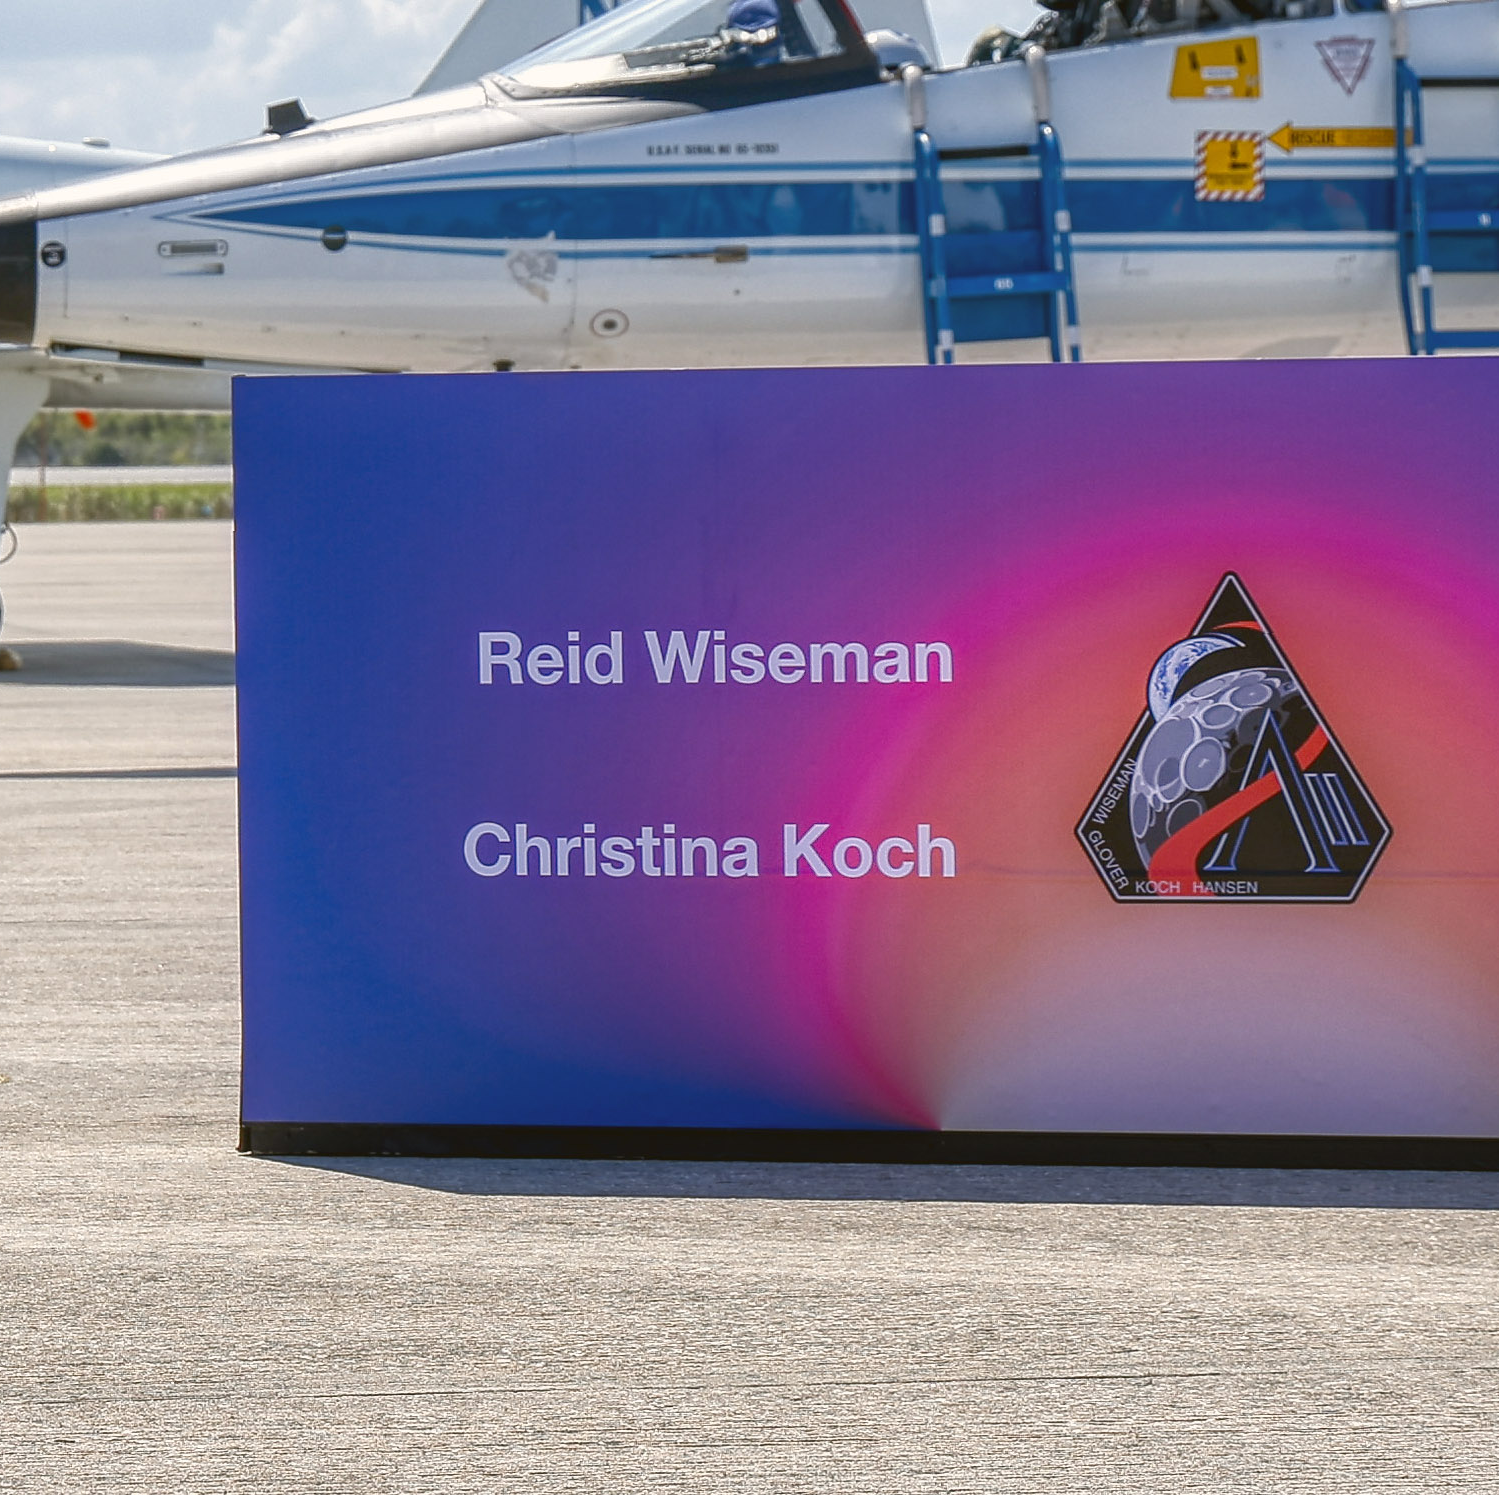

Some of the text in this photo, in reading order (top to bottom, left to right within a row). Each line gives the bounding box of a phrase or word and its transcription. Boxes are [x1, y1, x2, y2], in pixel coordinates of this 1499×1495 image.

[479, 630, 954, 685] Reid Wiseman
[1093, 758, 1138, 825] WISEMAN
[463, 822, 956, 879] Christina Koch
[1088, 830, 1130, 890] GLOVER
[1135, 881, 1258, 893] KOCH HANSEN
